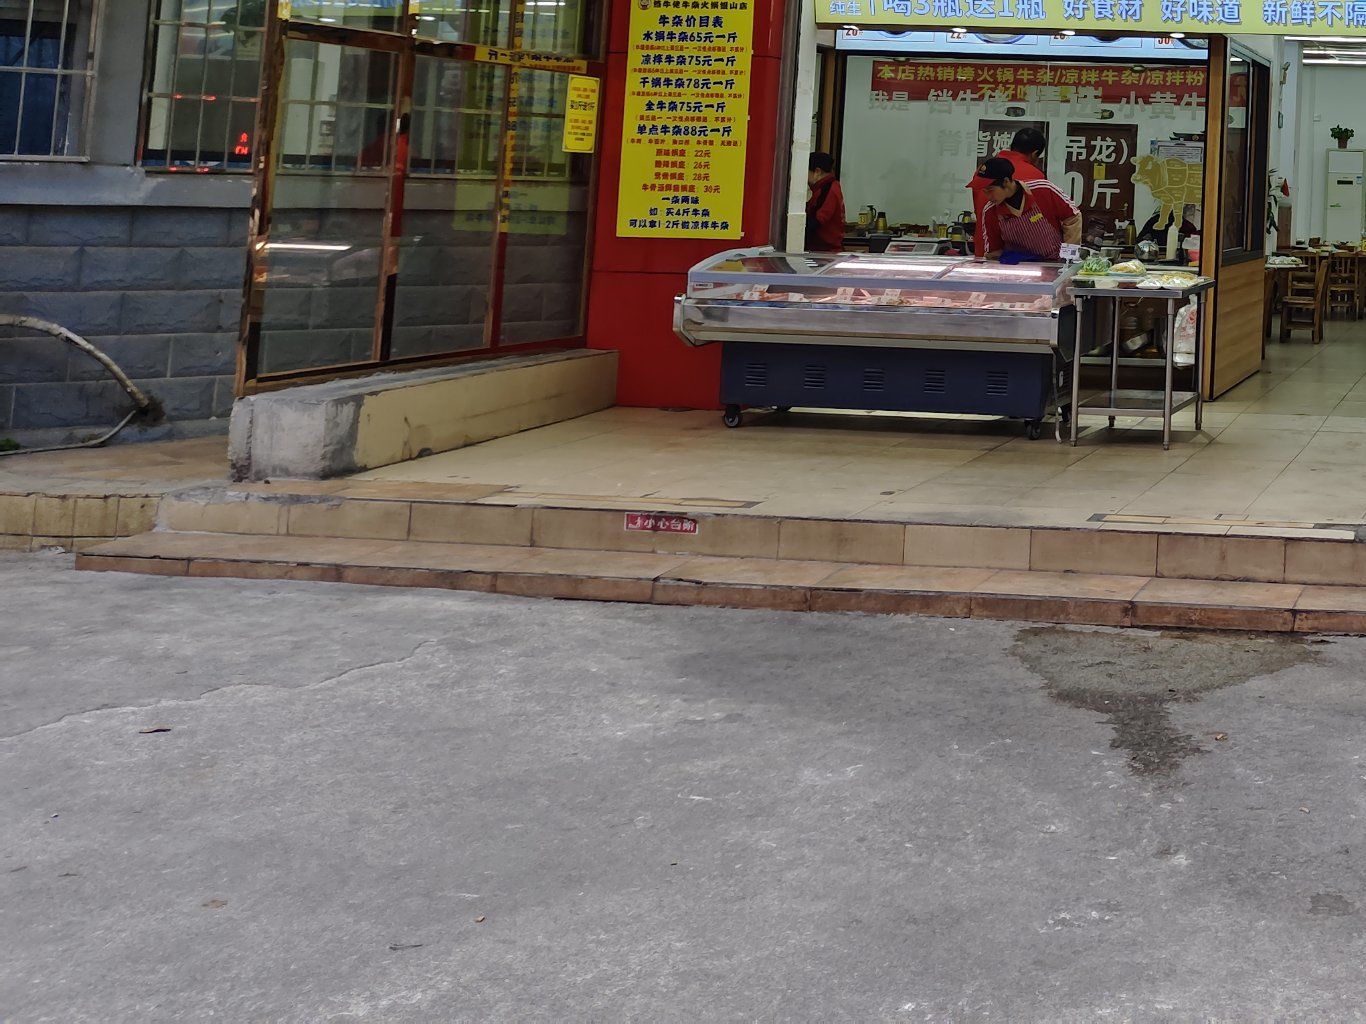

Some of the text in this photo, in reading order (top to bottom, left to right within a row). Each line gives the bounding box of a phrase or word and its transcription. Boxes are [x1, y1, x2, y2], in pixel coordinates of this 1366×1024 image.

[829, 0, 861, 16] 纯生
[658, 15, 724, 28] 牛杂价目表
[642, 31, 738, 43] 水锅牛杂65元一斤
[641, 54, 737, 67] 凉拌牛杂75元一斤
[639, 77, 736, 90] 干锅牛杂78元一斤
[645, 100, 727, 113] 全牛杂75元一斤
[636, 124, 733, 137] 单点牛杂88元一斤
[643, 517, 695, 531] 小心台阶
